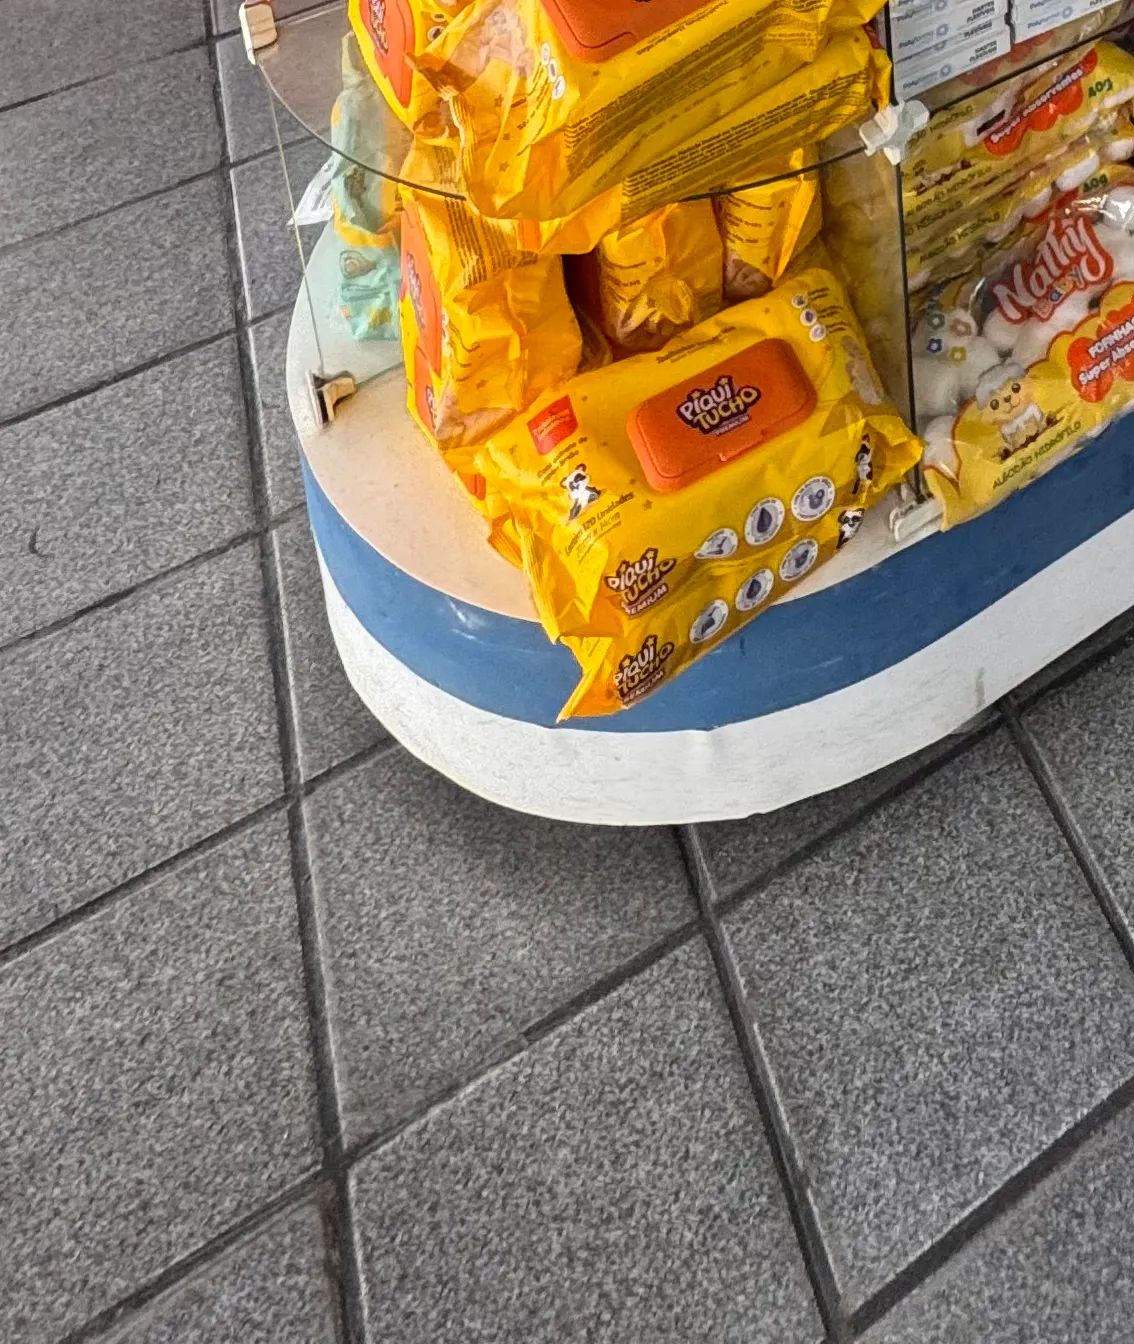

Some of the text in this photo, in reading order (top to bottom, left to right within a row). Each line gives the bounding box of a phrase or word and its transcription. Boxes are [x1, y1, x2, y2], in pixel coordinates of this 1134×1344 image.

[1088, 78, 1112, 98] 40g
[994, 217, 1106, 319] Nathy
[1078, 360, 1111, 386] Super
[678, 381, 736, 422] PIQUI
[694, 386, 762, 431] TUCHO
[608, 557, 654, 589] PIQUI
